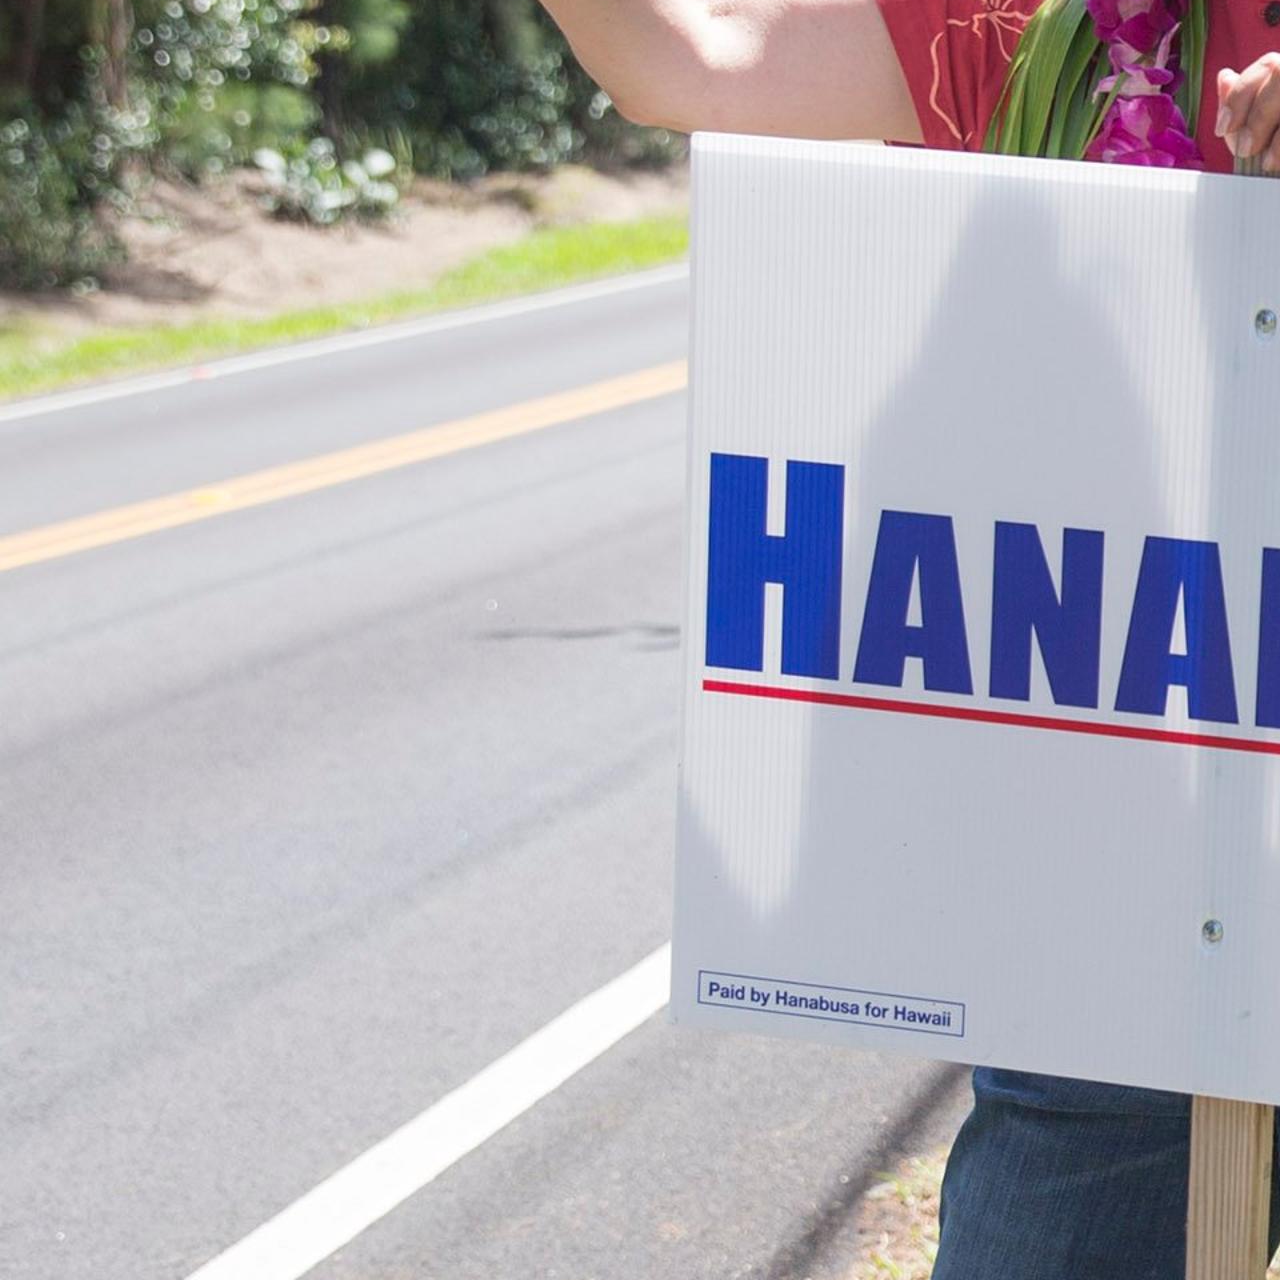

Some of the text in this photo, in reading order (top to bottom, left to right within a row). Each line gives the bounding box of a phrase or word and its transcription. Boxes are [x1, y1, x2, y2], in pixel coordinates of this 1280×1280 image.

[708, 981, 953, 1028] Paid by Hanabusa for Hawaii
